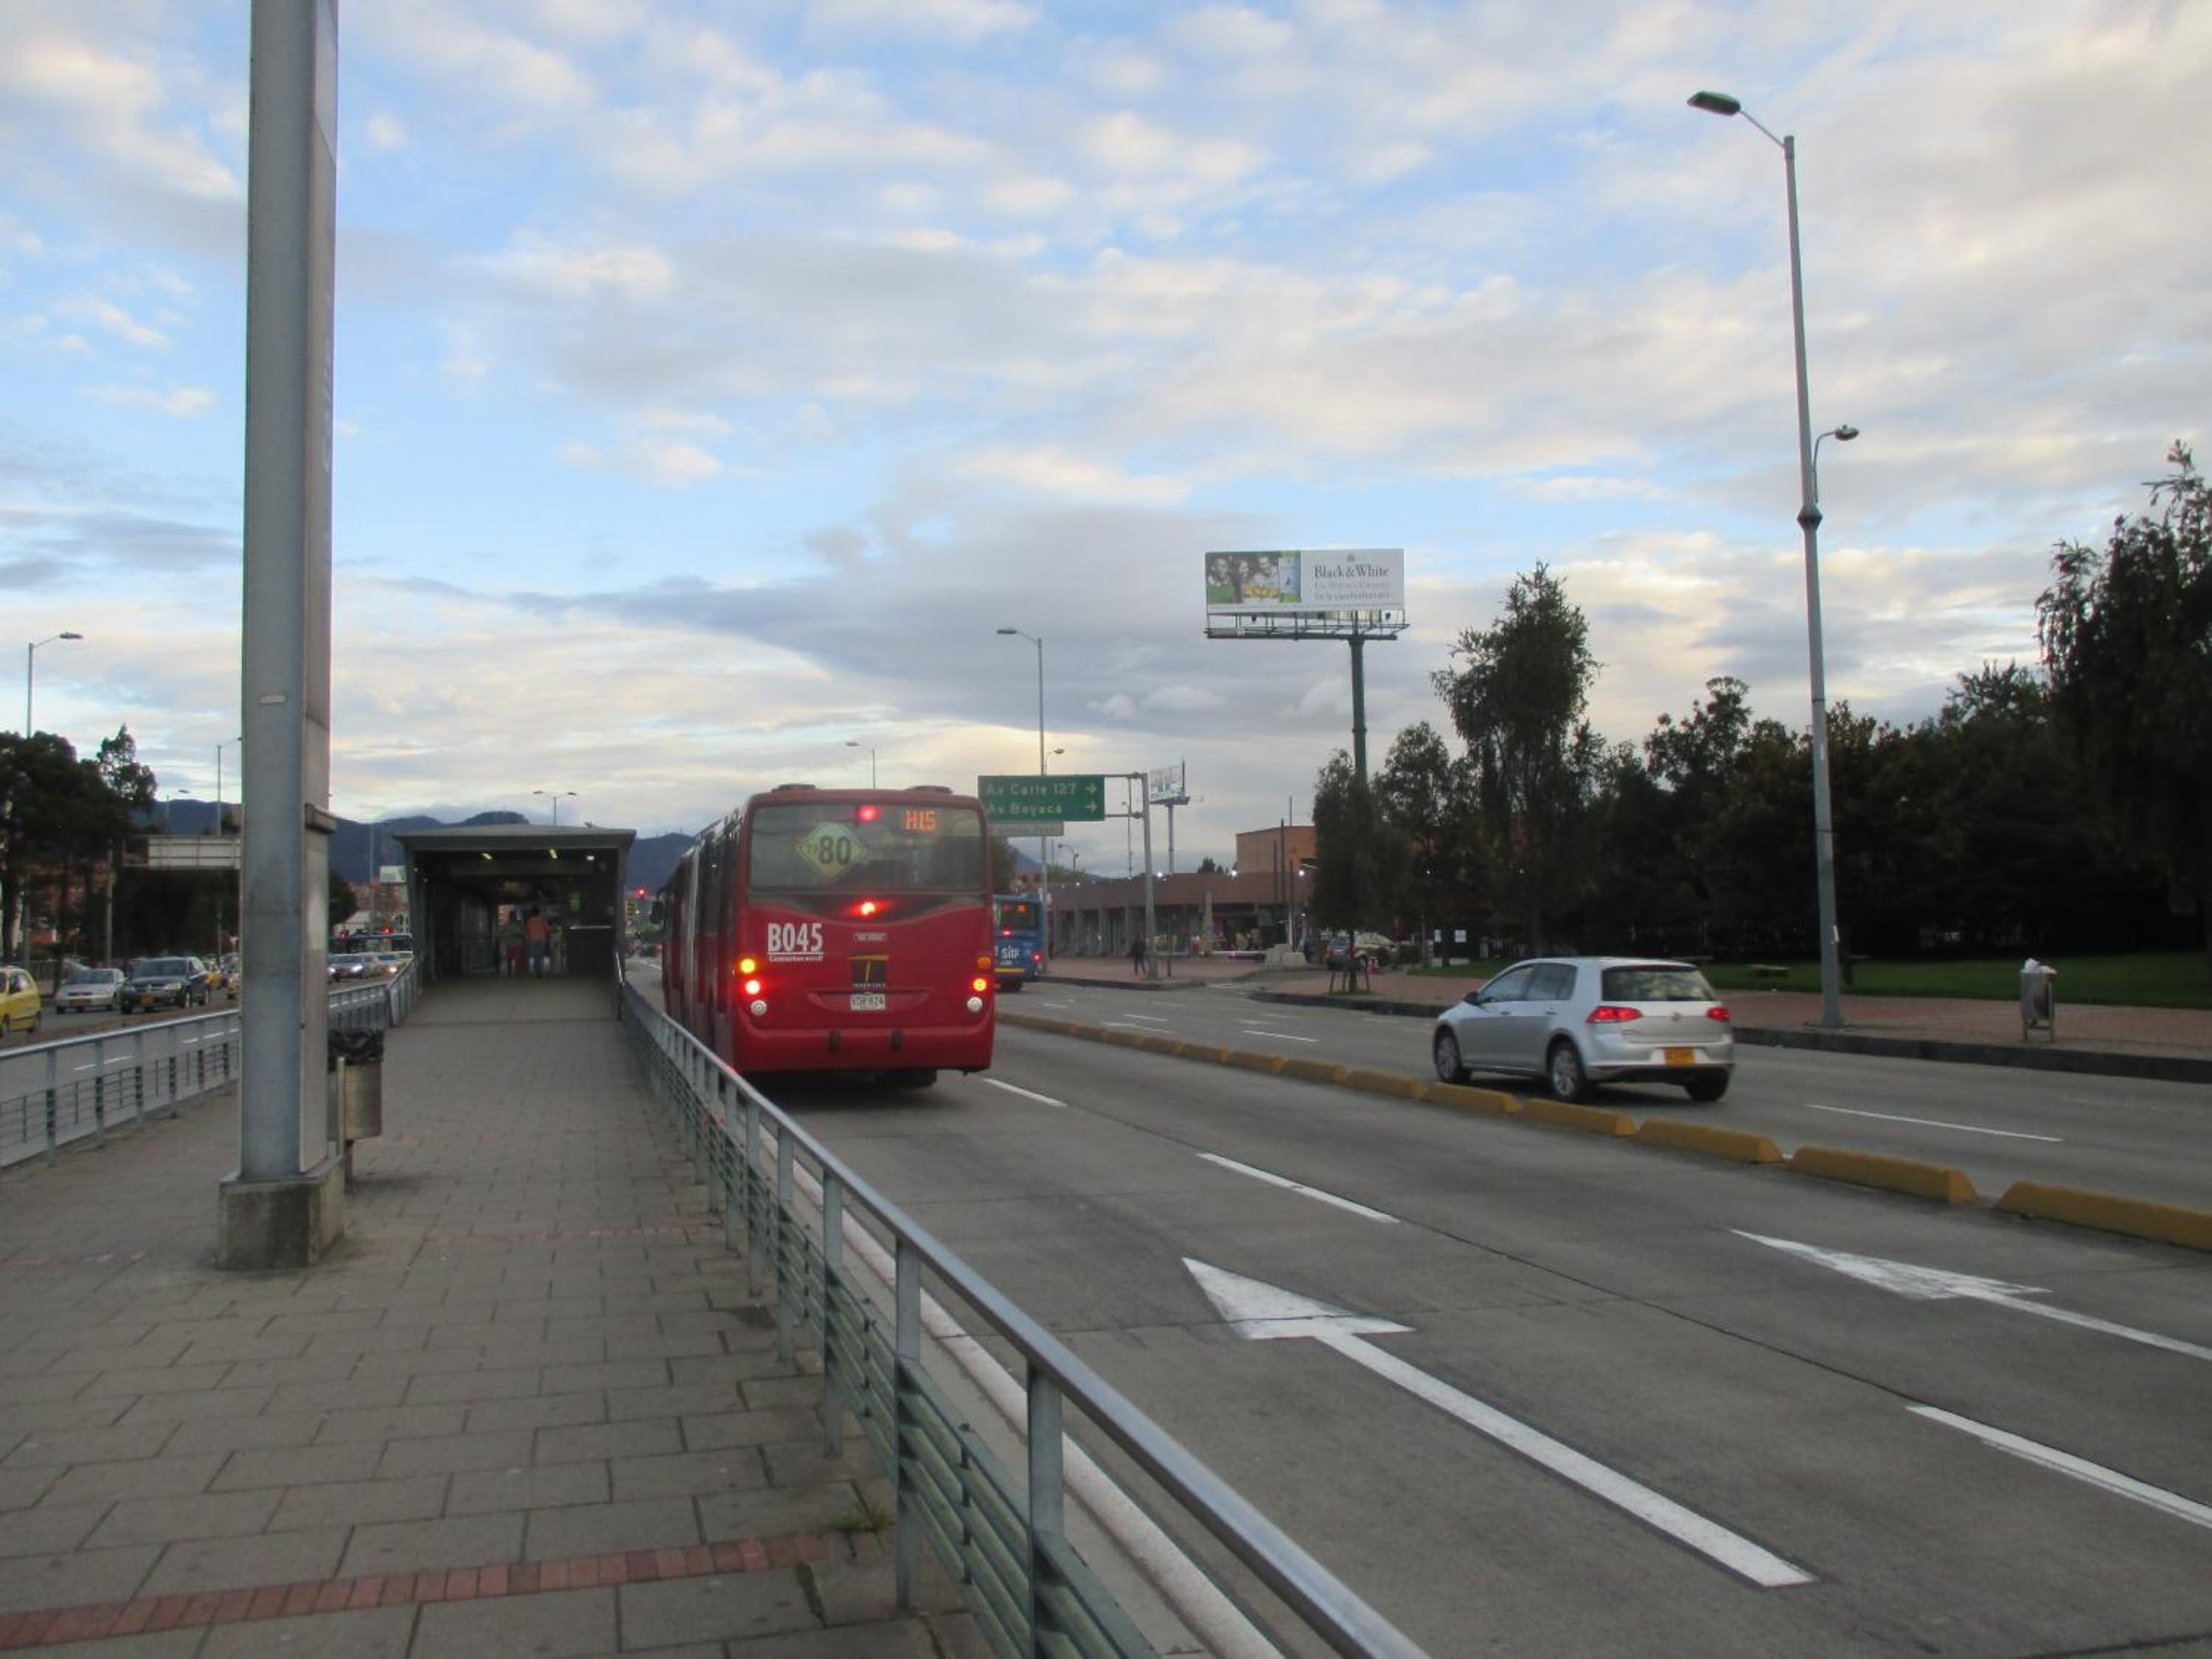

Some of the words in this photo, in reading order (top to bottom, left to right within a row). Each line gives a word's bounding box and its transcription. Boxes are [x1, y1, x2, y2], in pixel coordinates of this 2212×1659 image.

[1009, 782, 1048, 796] Calle
[1052, 782, 1077, 795] 127
[988, 803, 1005, 815] Av
[905, 810, 936, 831] H15
[818, 835, 852, 866] 80
[768, 922, 823, 952] B045
